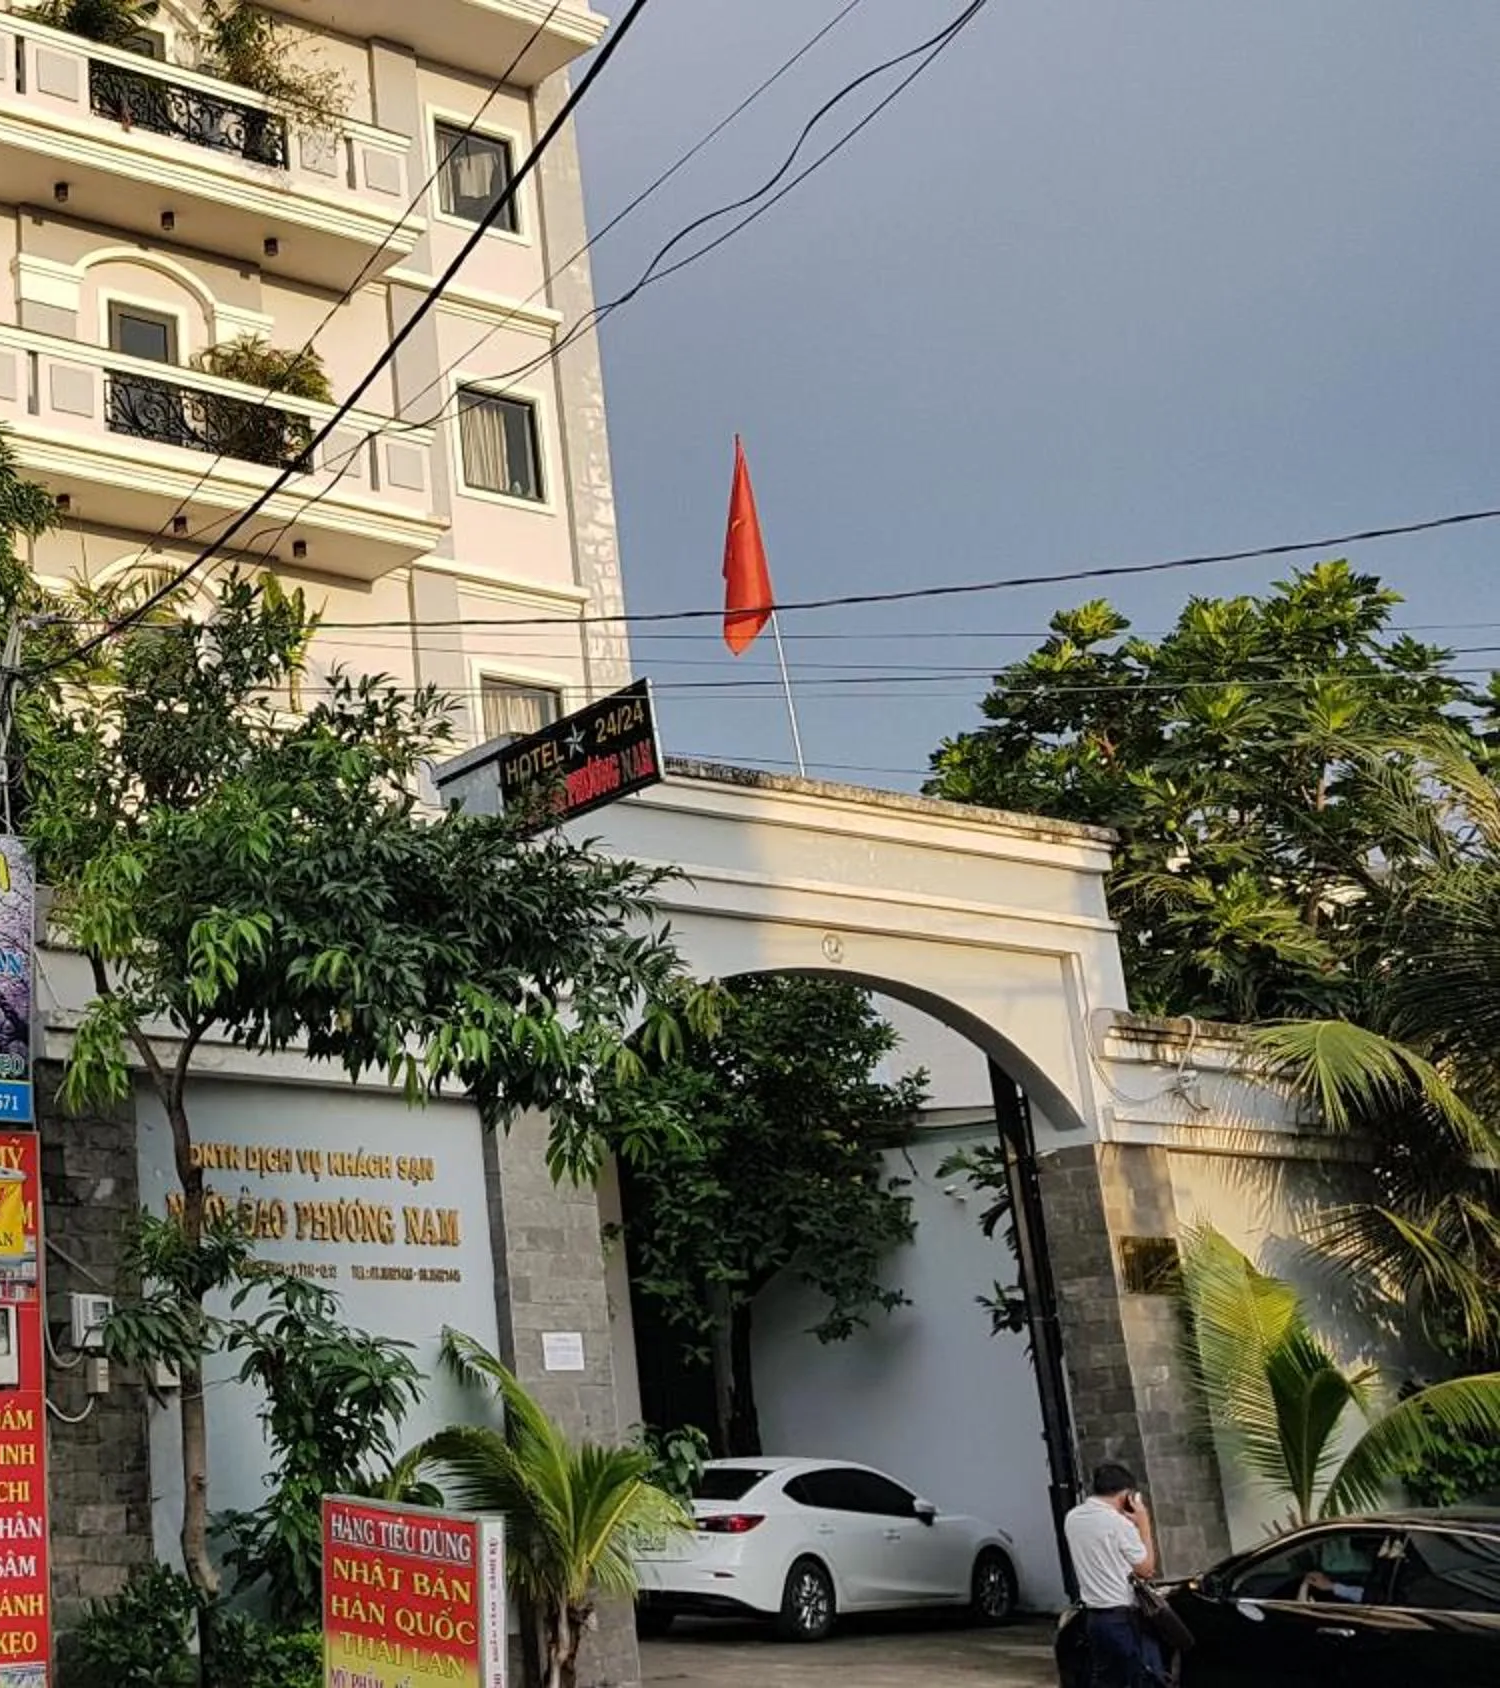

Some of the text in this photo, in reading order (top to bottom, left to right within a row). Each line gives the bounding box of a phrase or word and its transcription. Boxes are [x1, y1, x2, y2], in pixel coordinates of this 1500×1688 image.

[505, 700, 645, 785] HOTEL 24/24
[245, 1144, 293, 1178] DỊCH
[296, 1149, 323, 1182] VỤ
[327, 1147, 393, 1181] KHÁCH
[401, 1204, 461, 1248] NAM
[332, 1556, 472, 1605] NHẬT BẢN
[394, 1606, 477, 1646] QUỐC
[412, 1647, 466, 1679] LAN
